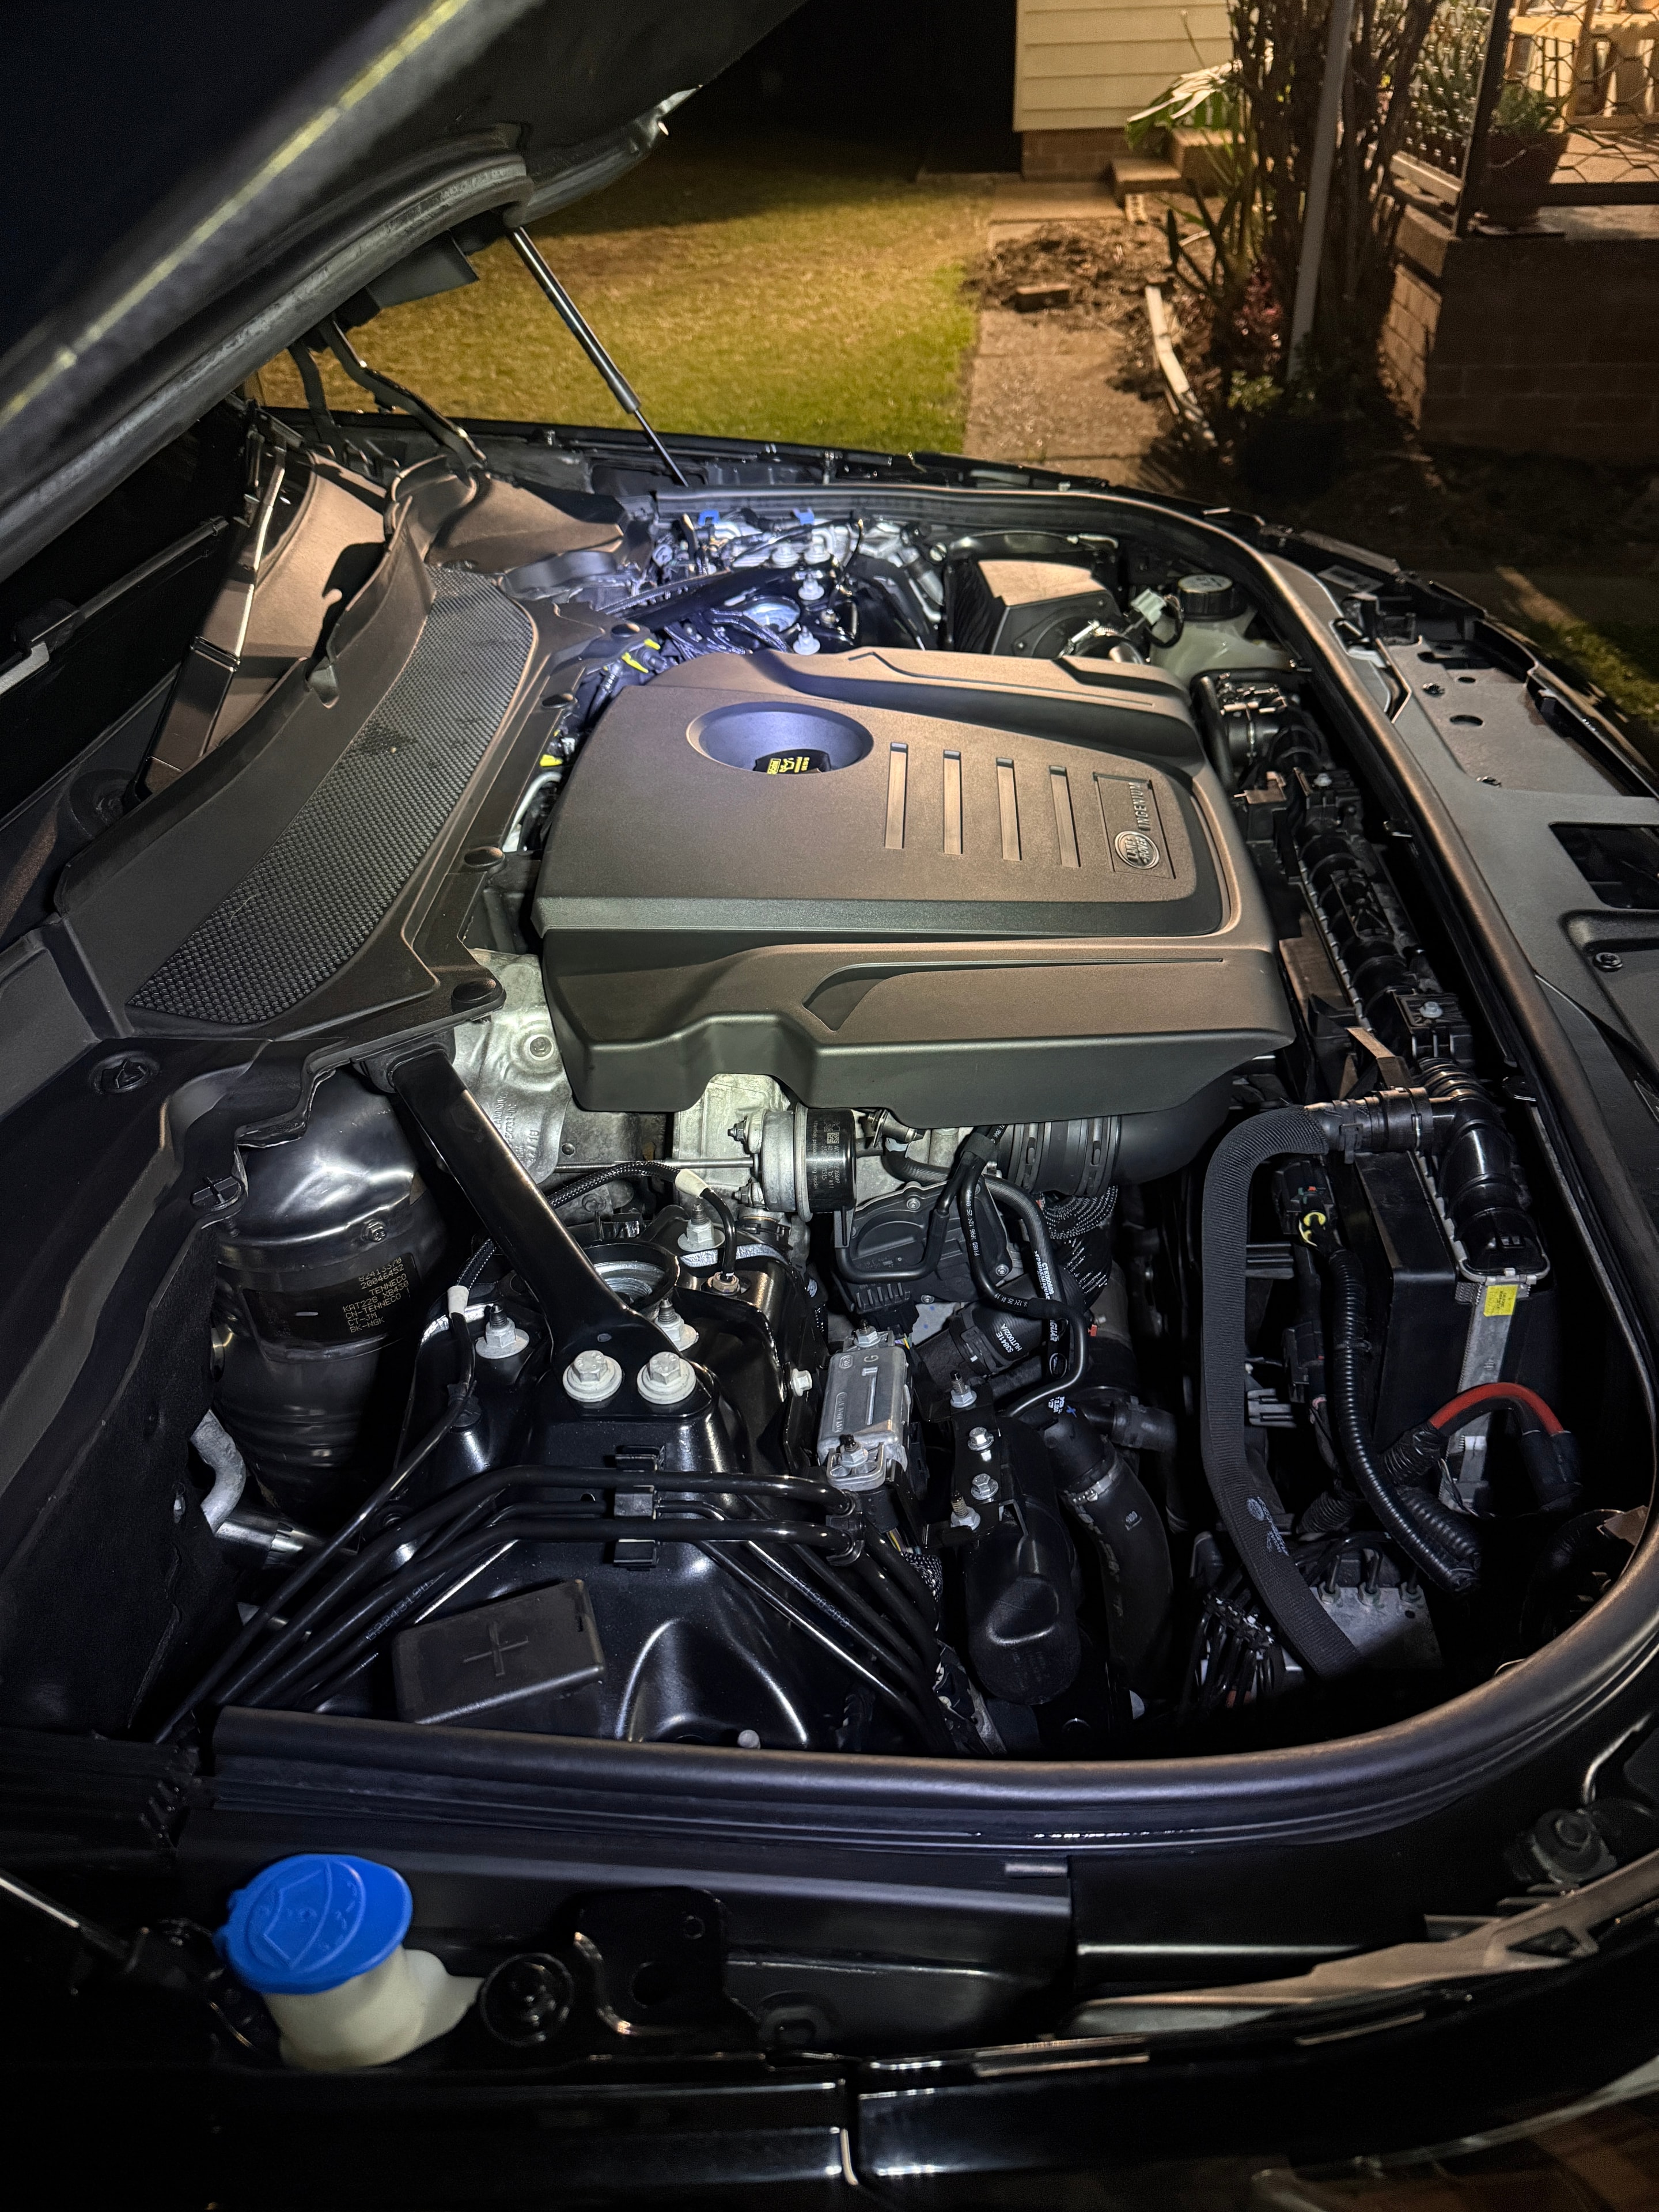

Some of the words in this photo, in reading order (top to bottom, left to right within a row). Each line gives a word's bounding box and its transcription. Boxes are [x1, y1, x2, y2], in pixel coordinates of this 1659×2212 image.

[1128, 781, 1151, 831] INGENIUM
[369, 1273, 407, 1296] TENNECO
[346, 1293, 402, 1319] CN-TENNECO
[1001, 1323, 1023, 1352] HUT002/A
